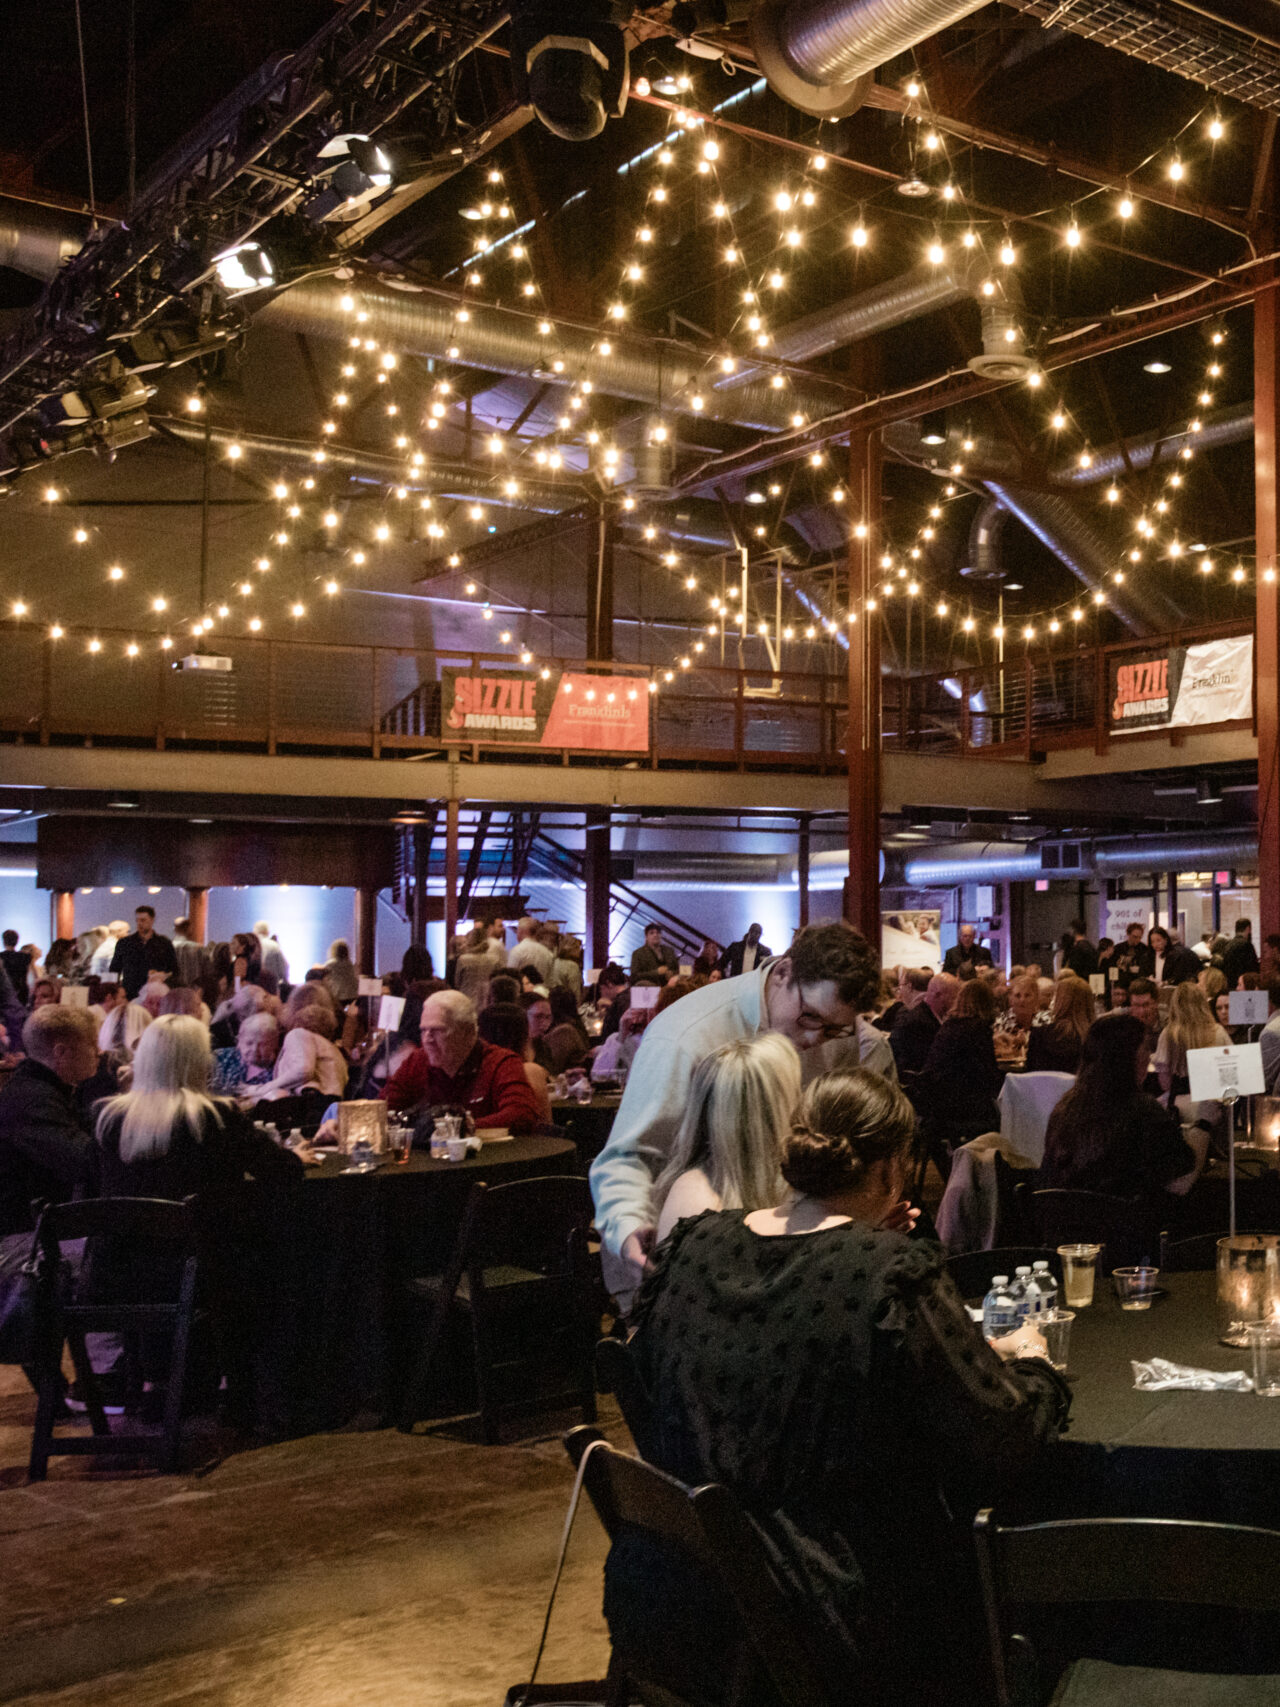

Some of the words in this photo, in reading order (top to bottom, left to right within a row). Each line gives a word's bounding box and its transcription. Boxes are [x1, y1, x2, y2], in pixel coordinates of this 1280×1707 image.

[1117, 659, 1168, 703] SIZZLE
[454, 677, 536, 716] SIZZLE
[1123, 697, 1168, 718] AWARDS
[463, 713, 537, 731] AWARDS
